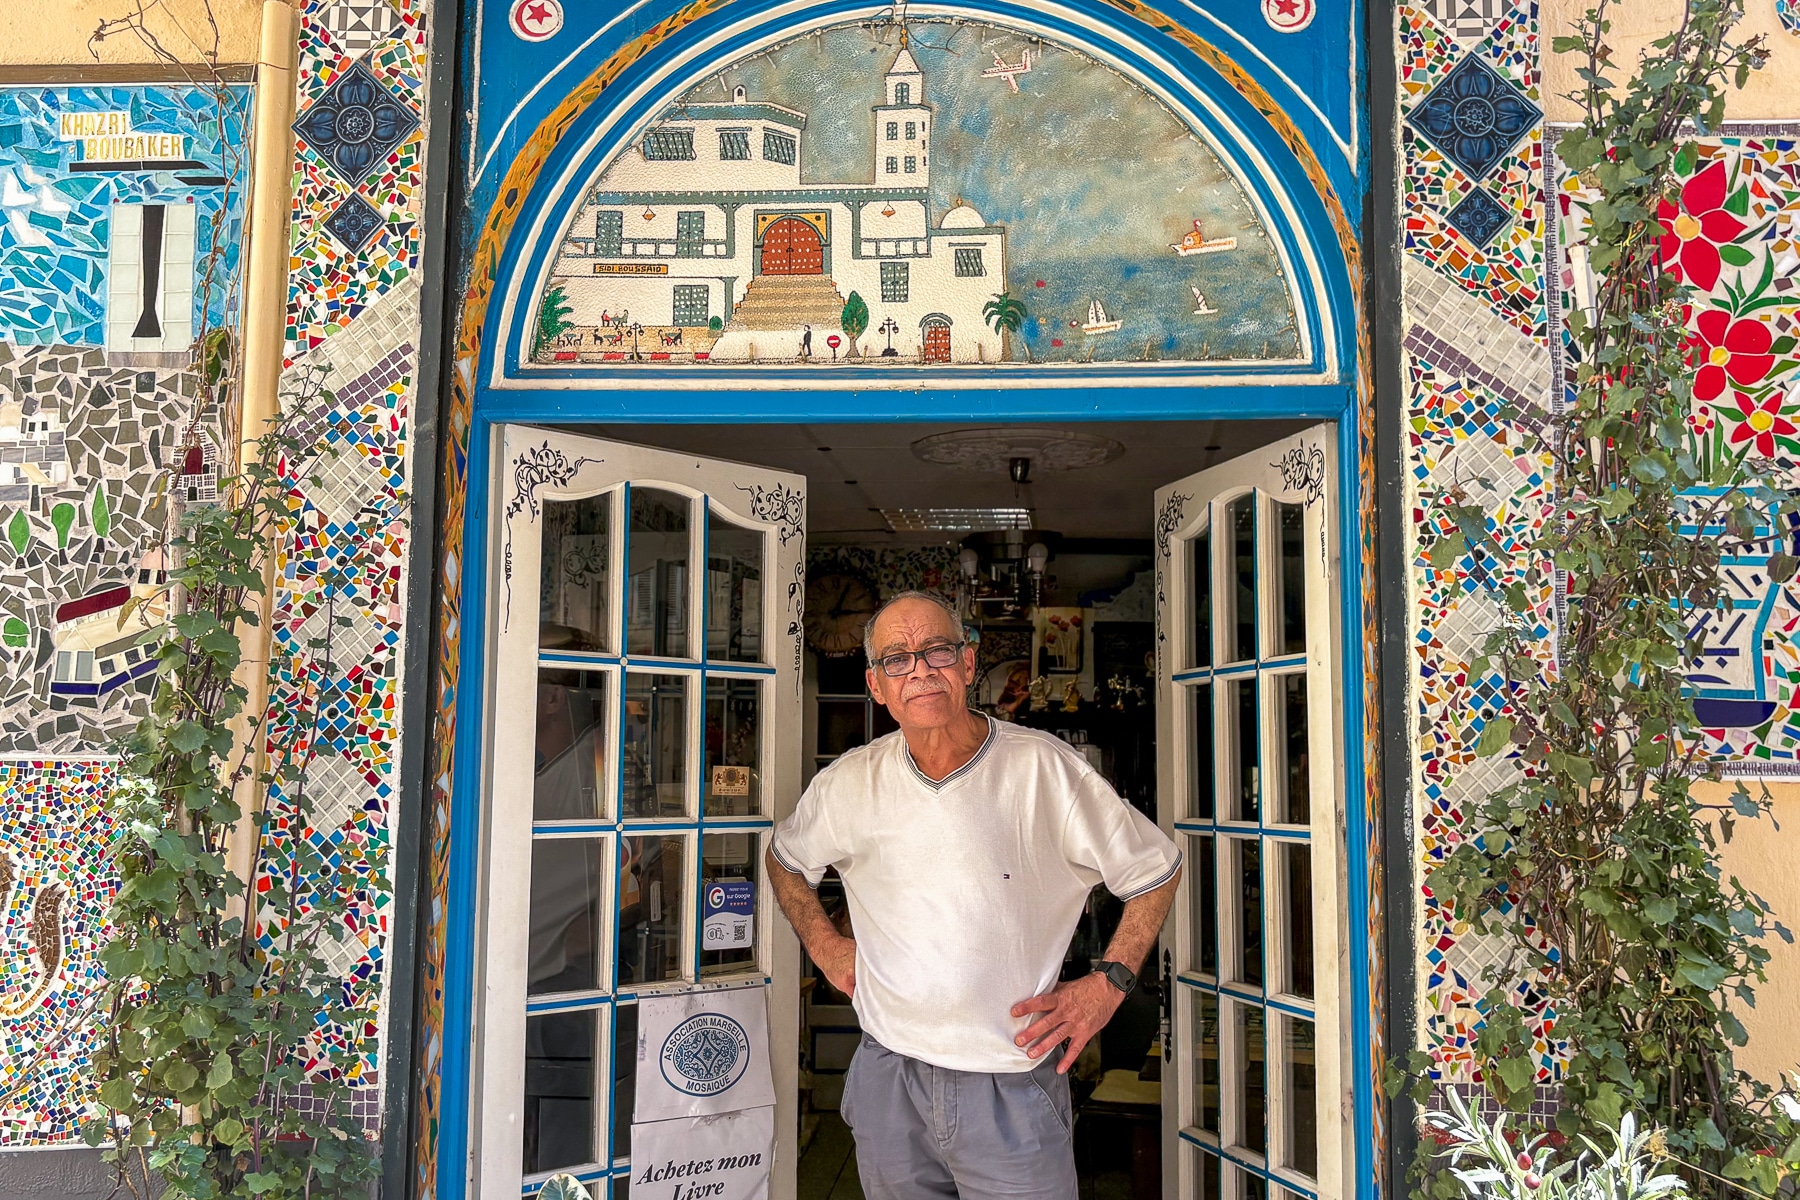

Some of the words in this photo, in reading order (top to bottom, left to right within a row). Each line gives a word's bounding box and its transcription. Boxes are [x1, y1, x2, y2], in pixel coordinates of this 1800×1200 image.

[61, 113, 126, 135] KHAZRI
[86, 135, 181, 160] BOUBAKER
[664, 1018, 708, 1061] ASSOCIATION
[709, 1017, 747, 1052] MARSEILLE
[685, 1074, 731, 1093] MOSAIQUE
[635, 1159, 715, 1186] Achetez
[717, 1152, 762, 1171] mon
[672, 1180, 725, 1200] Livre
